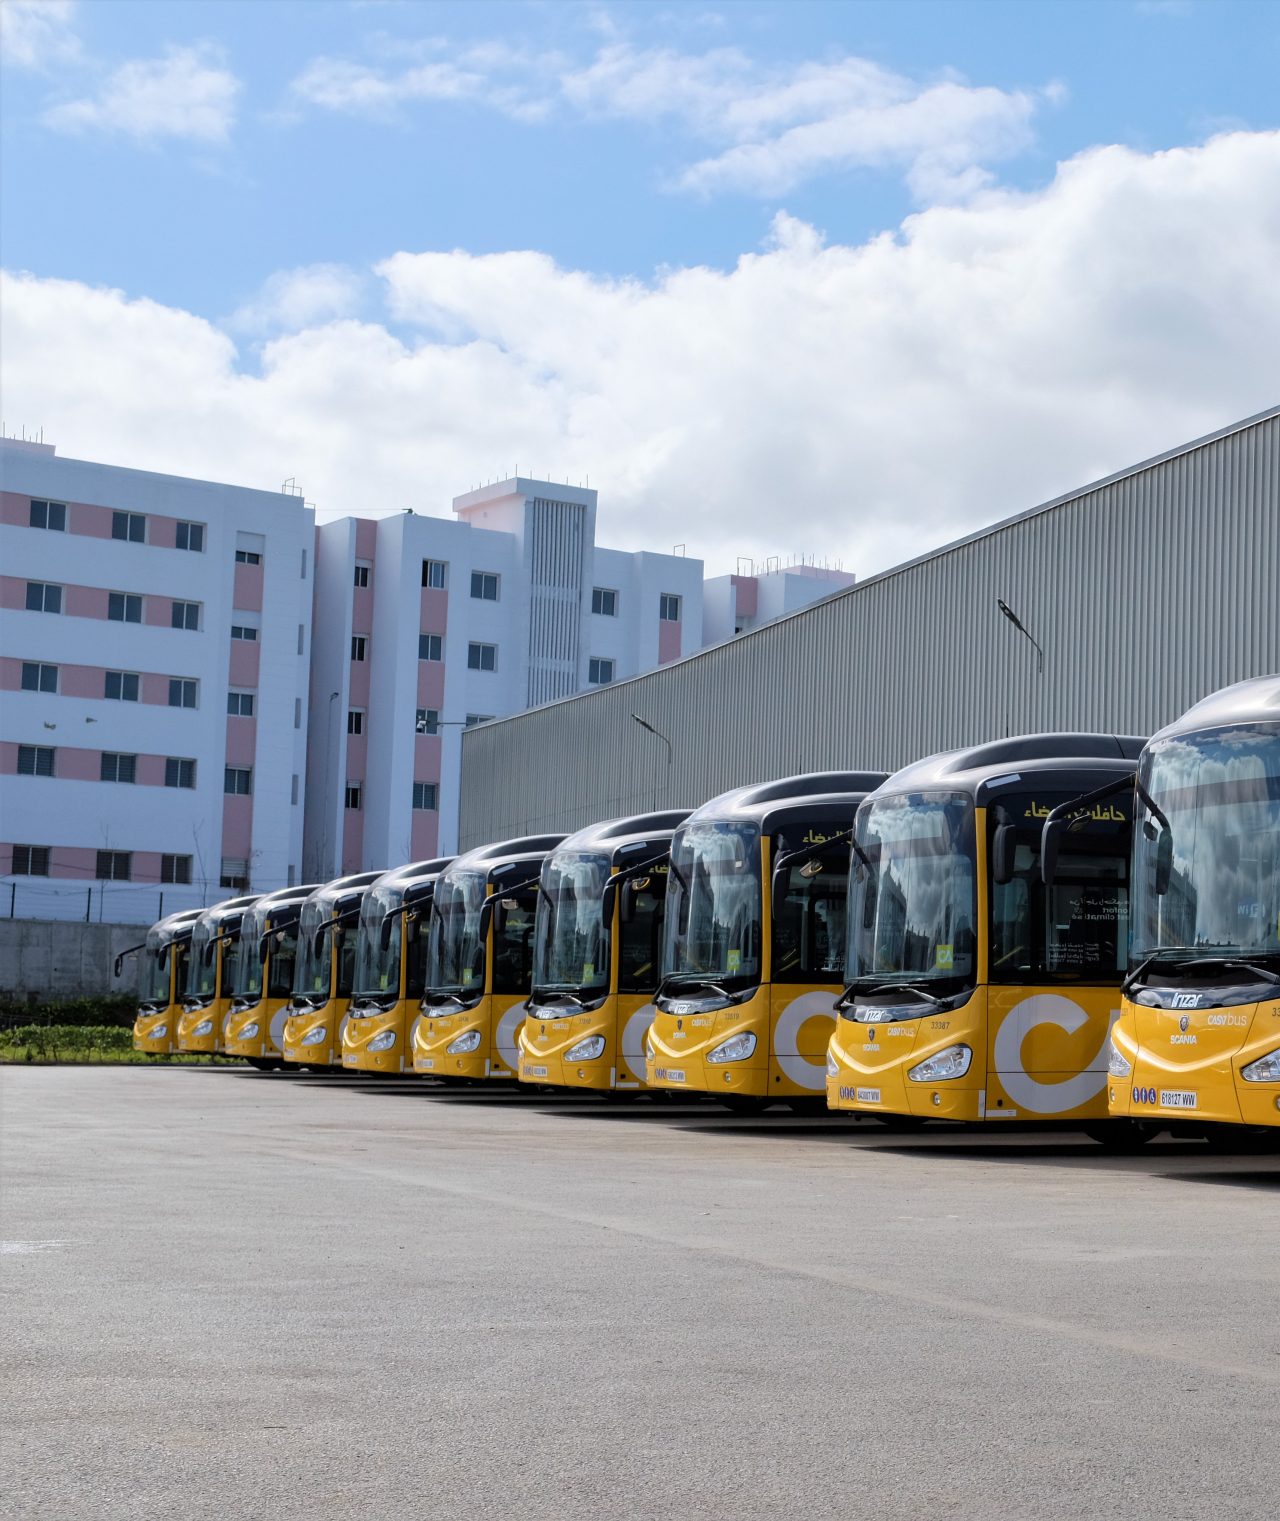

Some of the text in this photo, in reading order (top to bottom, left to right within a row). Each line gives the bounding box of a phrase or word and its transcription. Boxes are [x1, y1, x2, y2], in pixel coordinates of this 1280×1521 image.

[1171, 992, 1203, 1008] Irizar
[1170, 1035, 1198, 1045] SCANIA
[1161, 1092, 1196, 1106] 618127 WW
